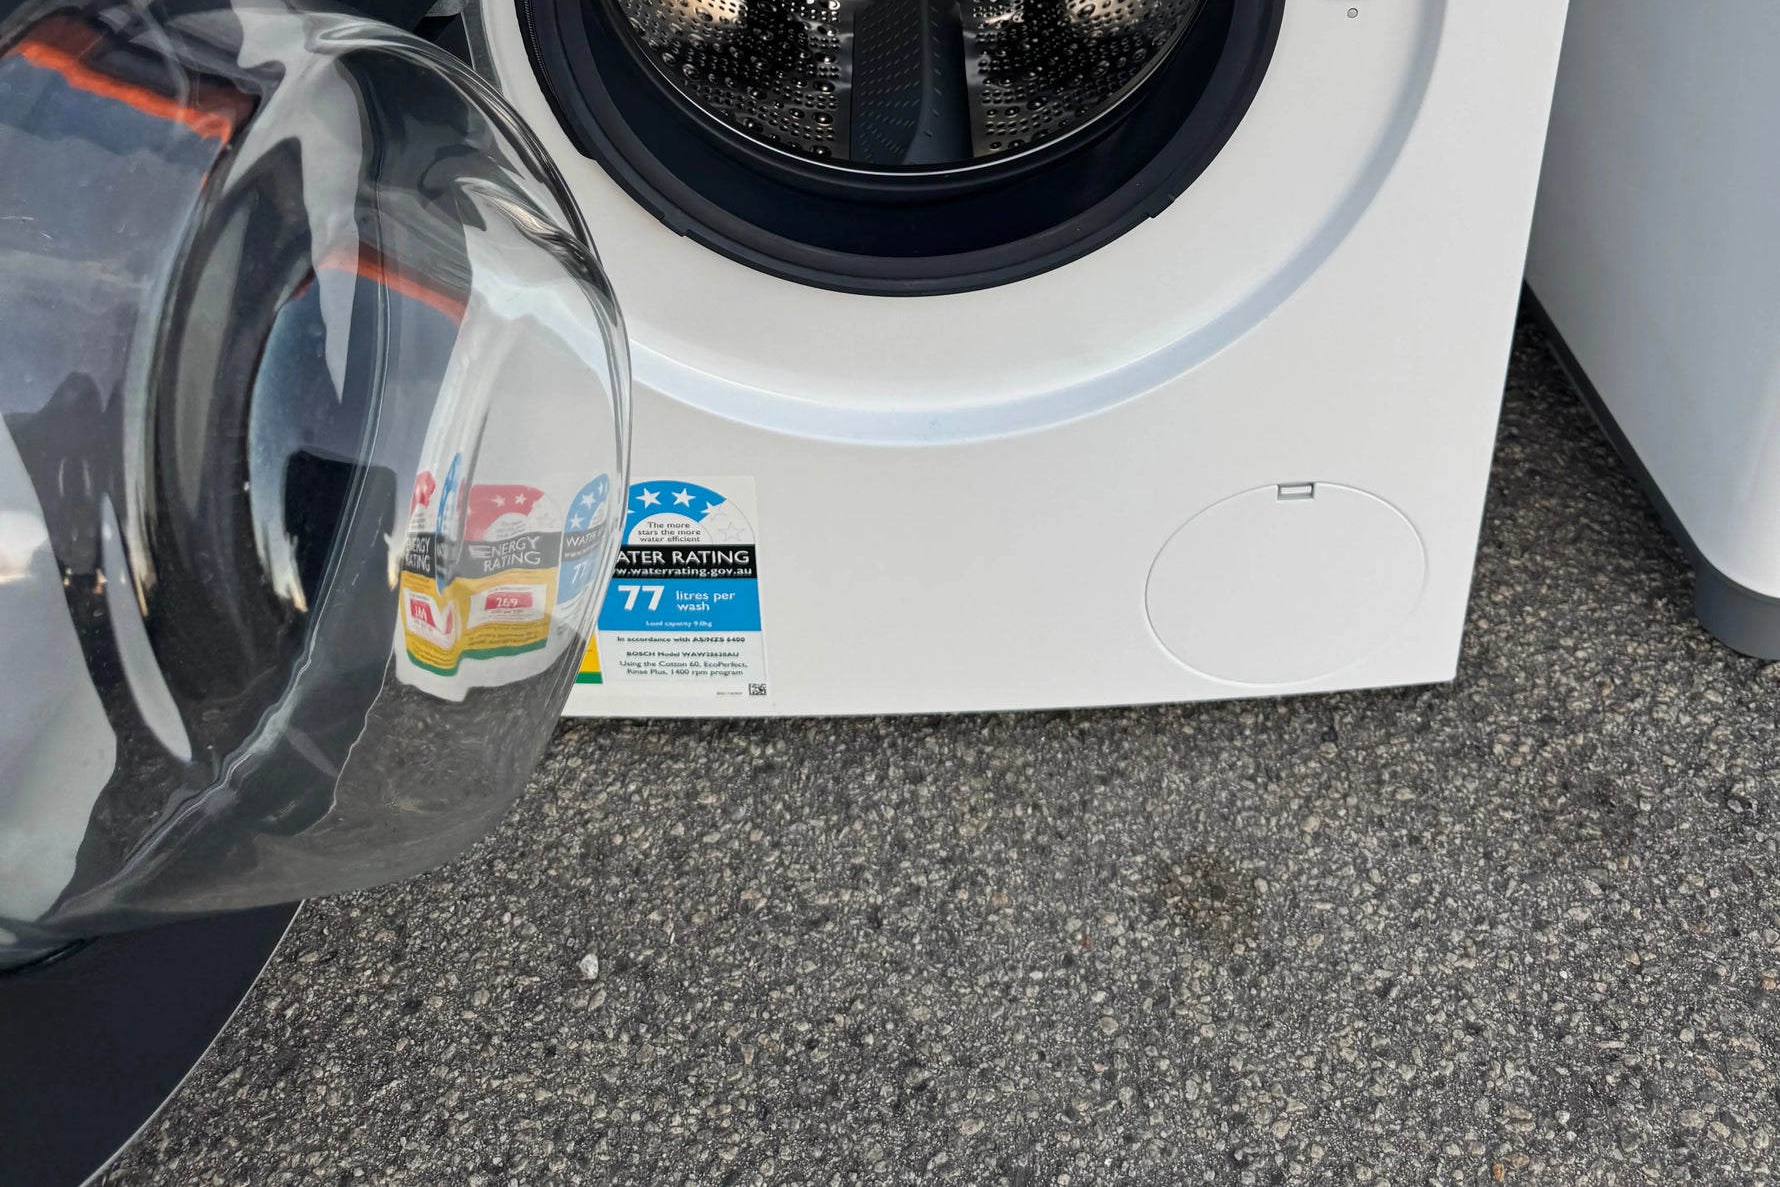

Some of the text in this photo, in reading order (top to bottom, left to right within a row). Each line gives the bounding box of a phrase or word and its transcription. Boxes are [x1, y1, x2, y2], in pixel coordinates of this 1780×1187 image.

[647, 521, 664, 529] The
[484, 551, 541, 573] RATING
[616, 550, 666, 564] ATER
[671, 550, 750, 565] RATING
[617, 584, 665, 611] 77
[675, 590, 736, 603] litres per
[677, 601, 711, 612] wash
